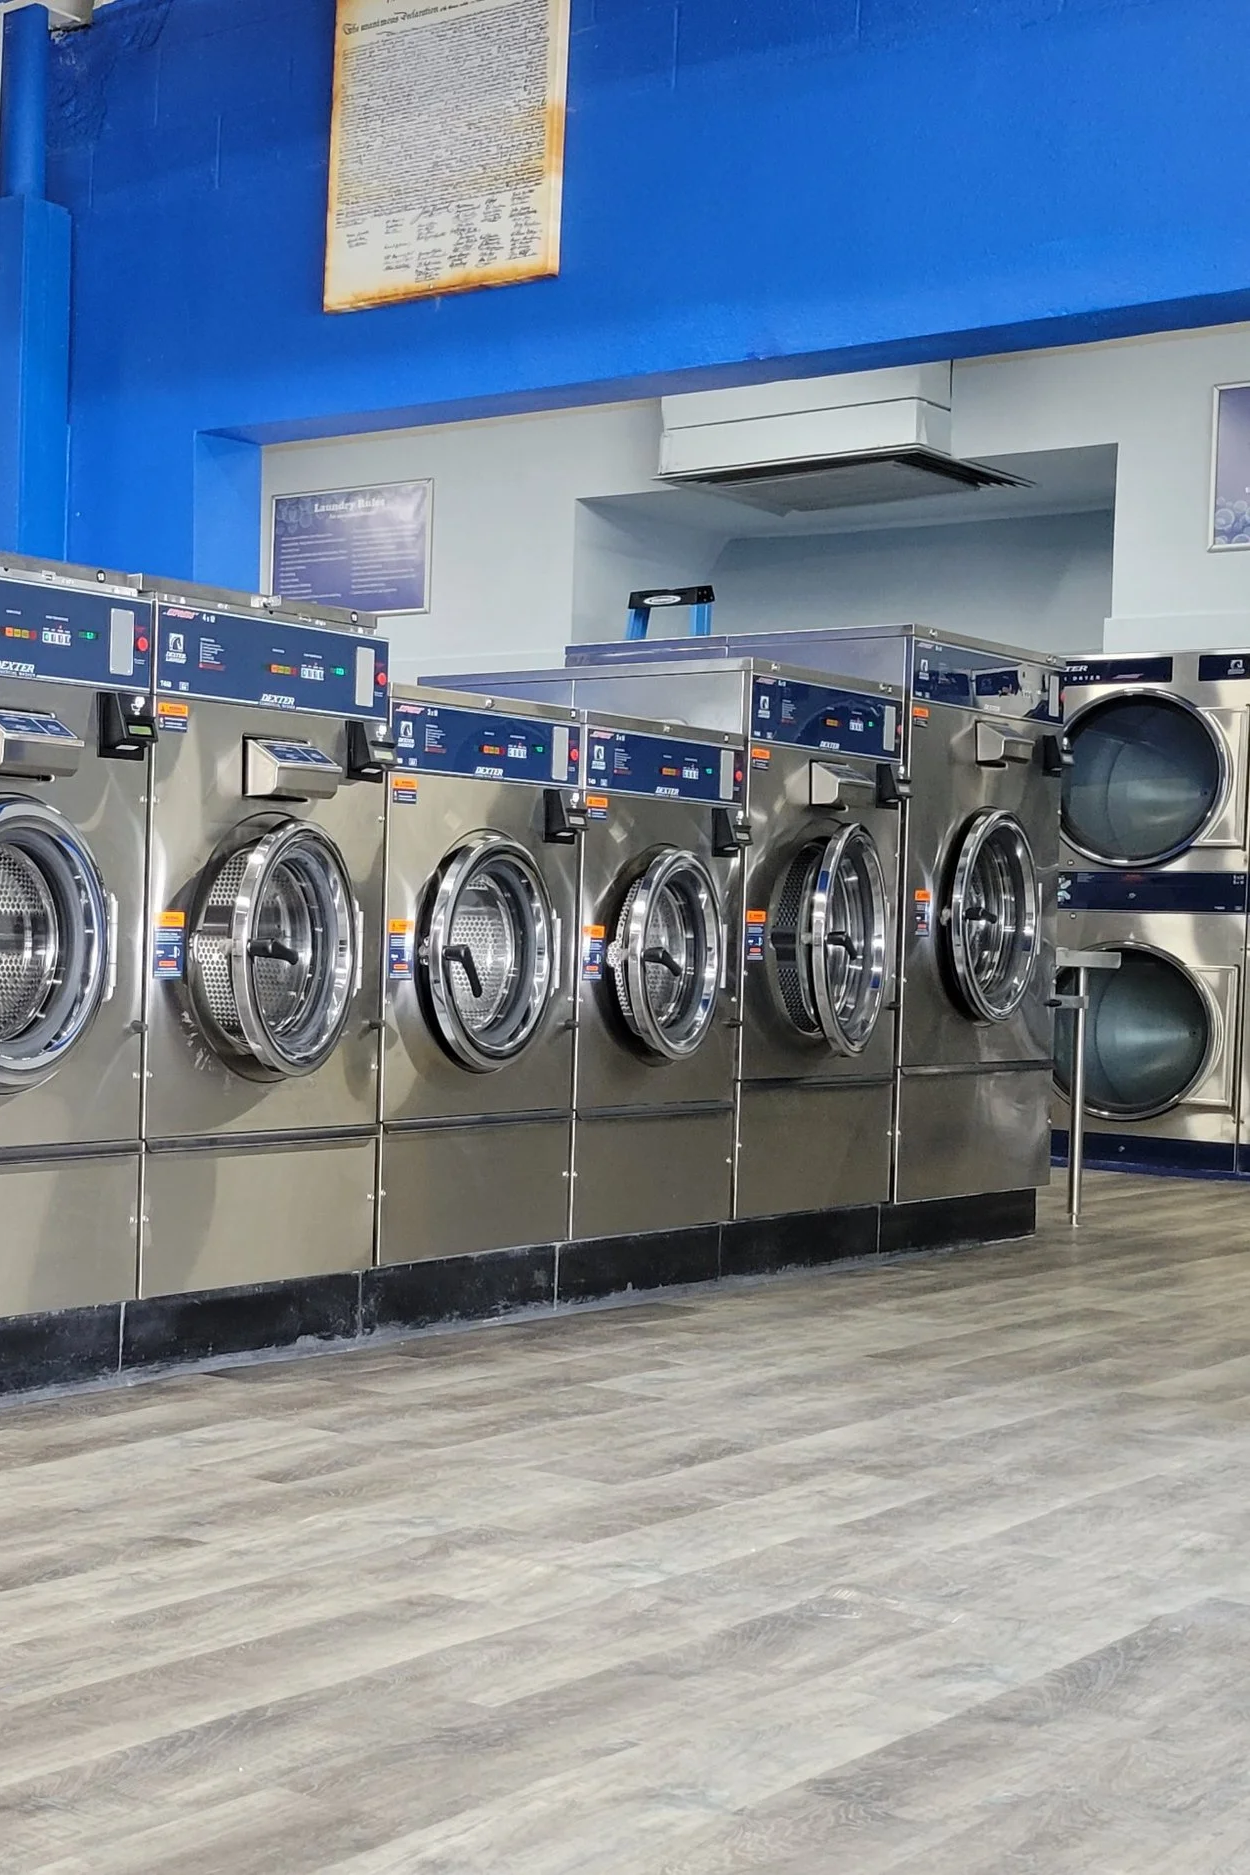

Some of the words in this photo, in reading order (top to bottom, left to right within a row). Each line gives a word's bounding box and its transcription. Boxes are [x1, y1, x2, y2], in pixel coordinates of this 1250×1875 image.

[314, 501, 355, 513] Laundry
[358, 498, 385, 509] Rules
[261, 693, 296, 706] DEXTER
[475, 766, 504, 777] DEXTER
